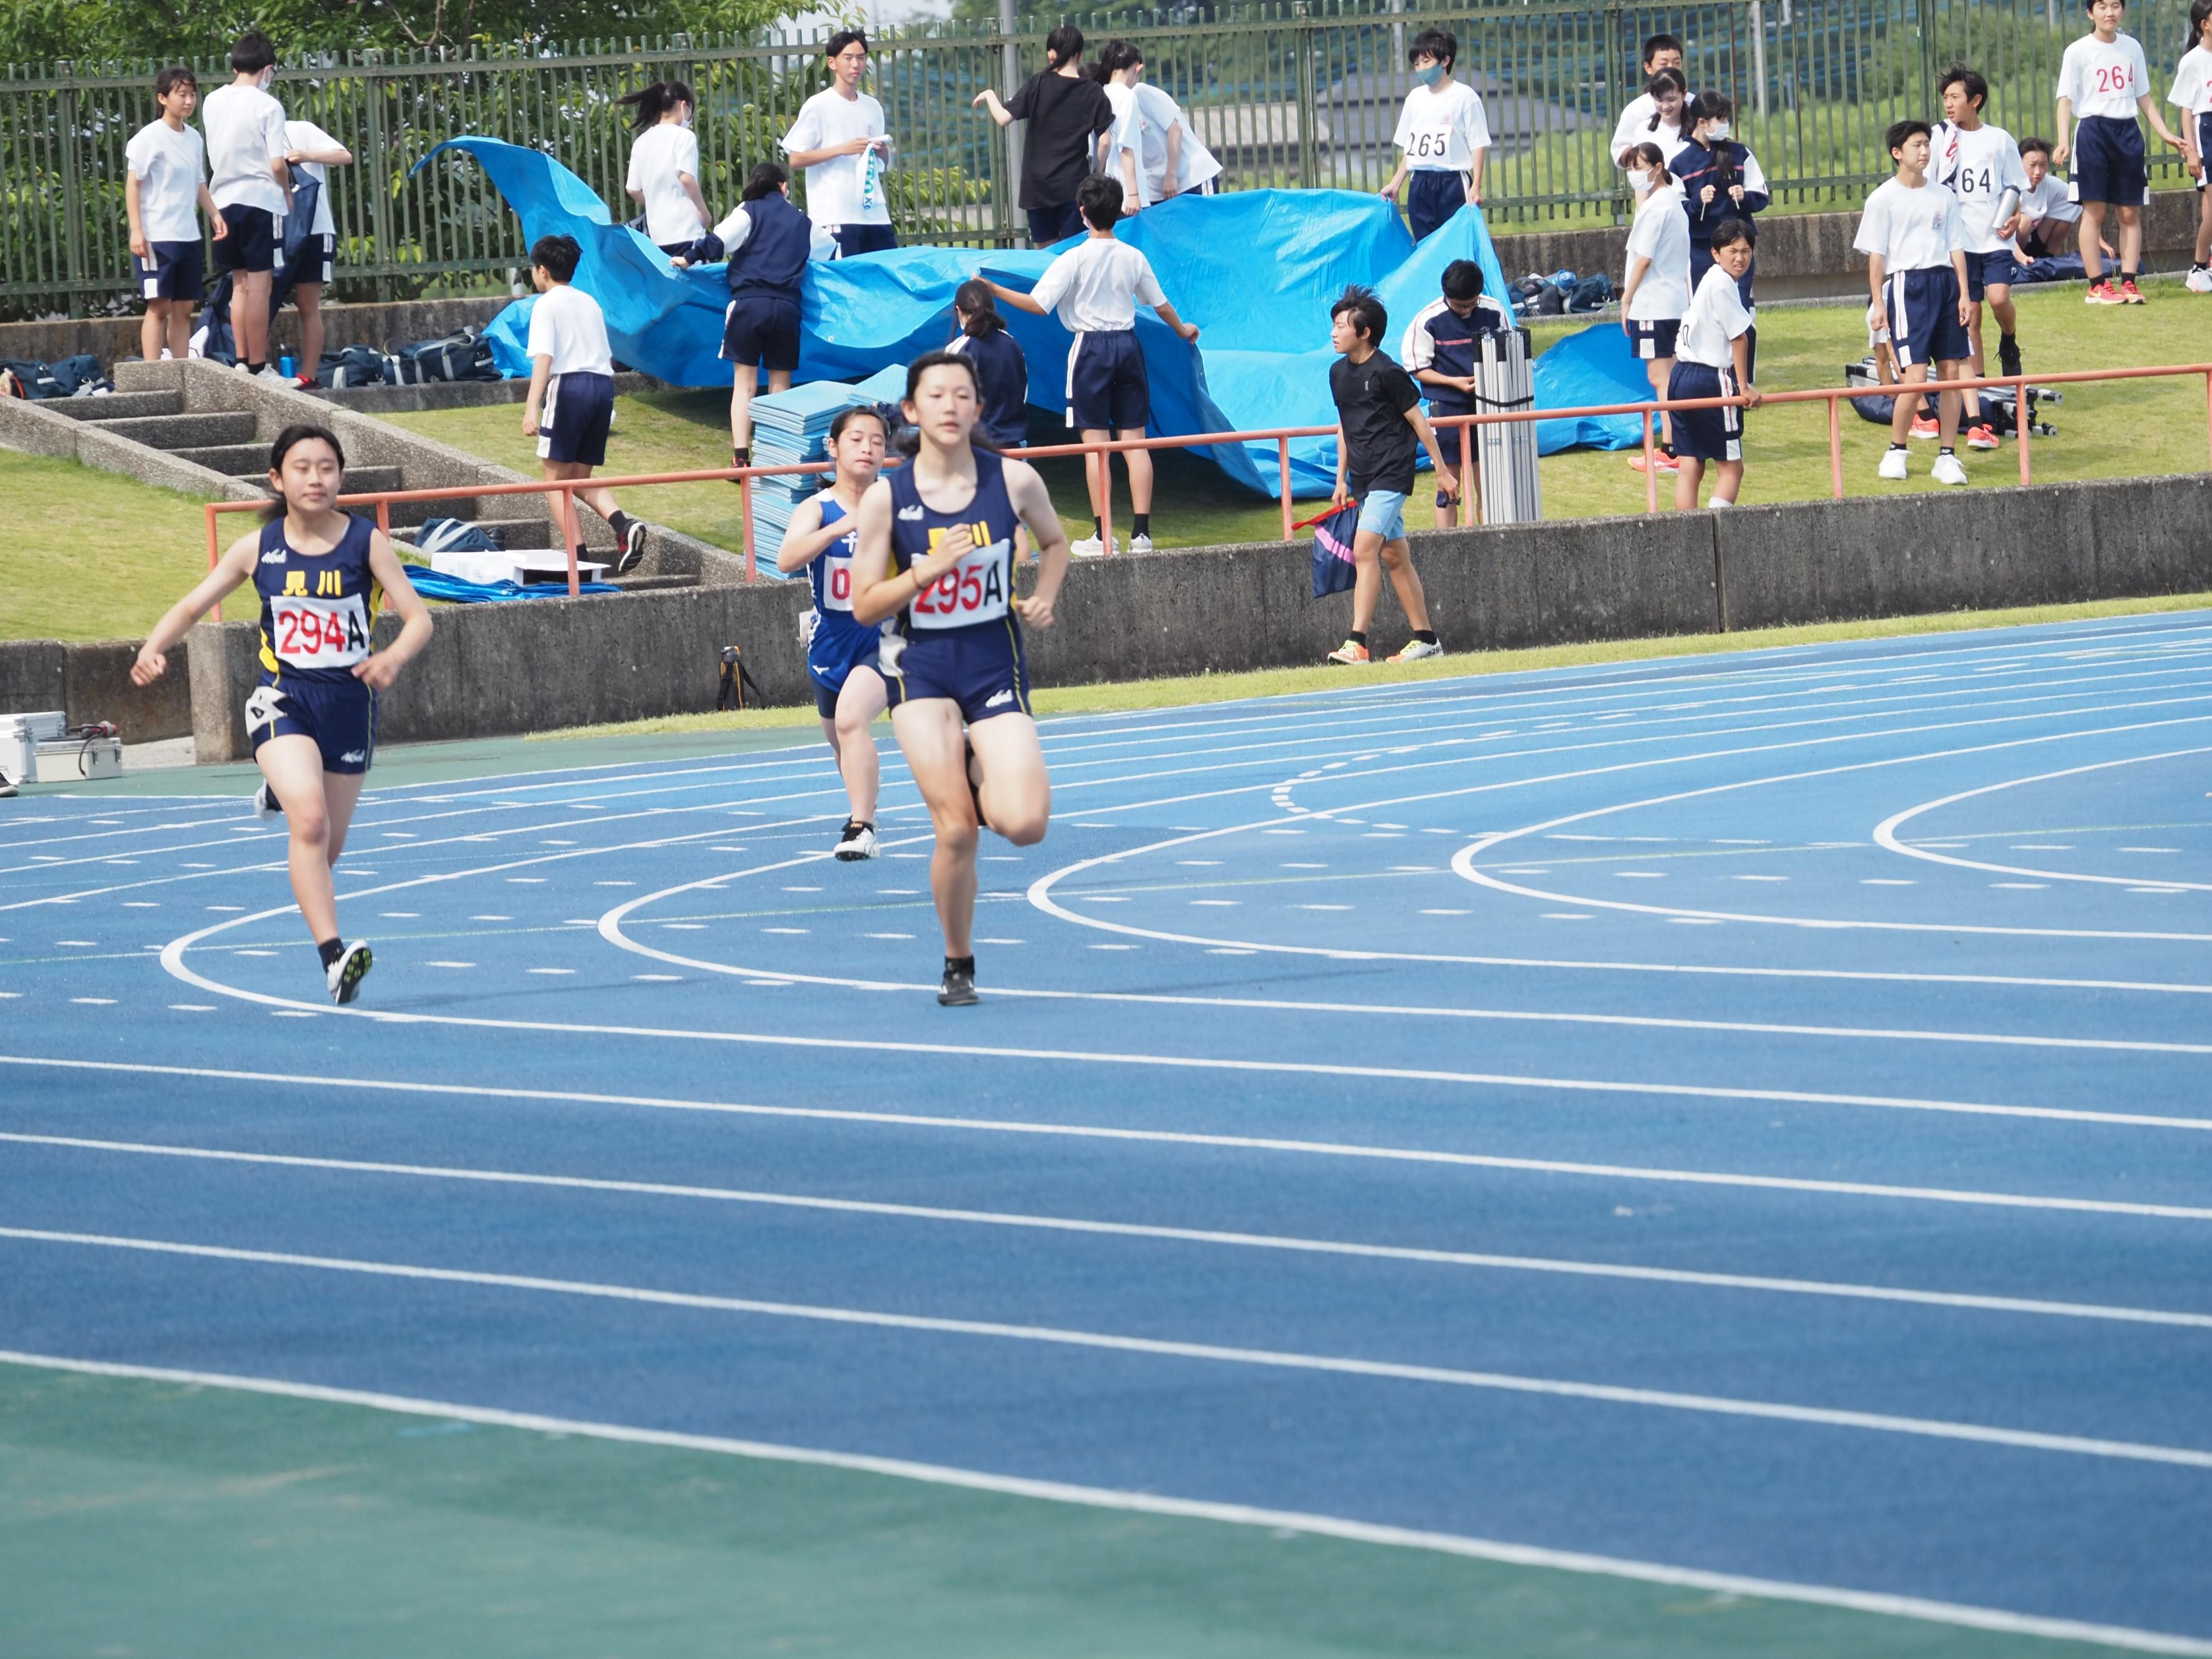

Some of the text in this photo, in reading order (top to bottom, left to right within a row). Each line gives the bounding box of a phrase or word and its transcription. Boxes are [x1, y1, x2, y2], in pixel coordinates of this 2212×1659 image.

[2097, 63, 2133, 92] 264
[1406, 132, 1446, 157] 265
[914, 560, 1002, 614] 295A
[278, 609, 365, 654] 294A
